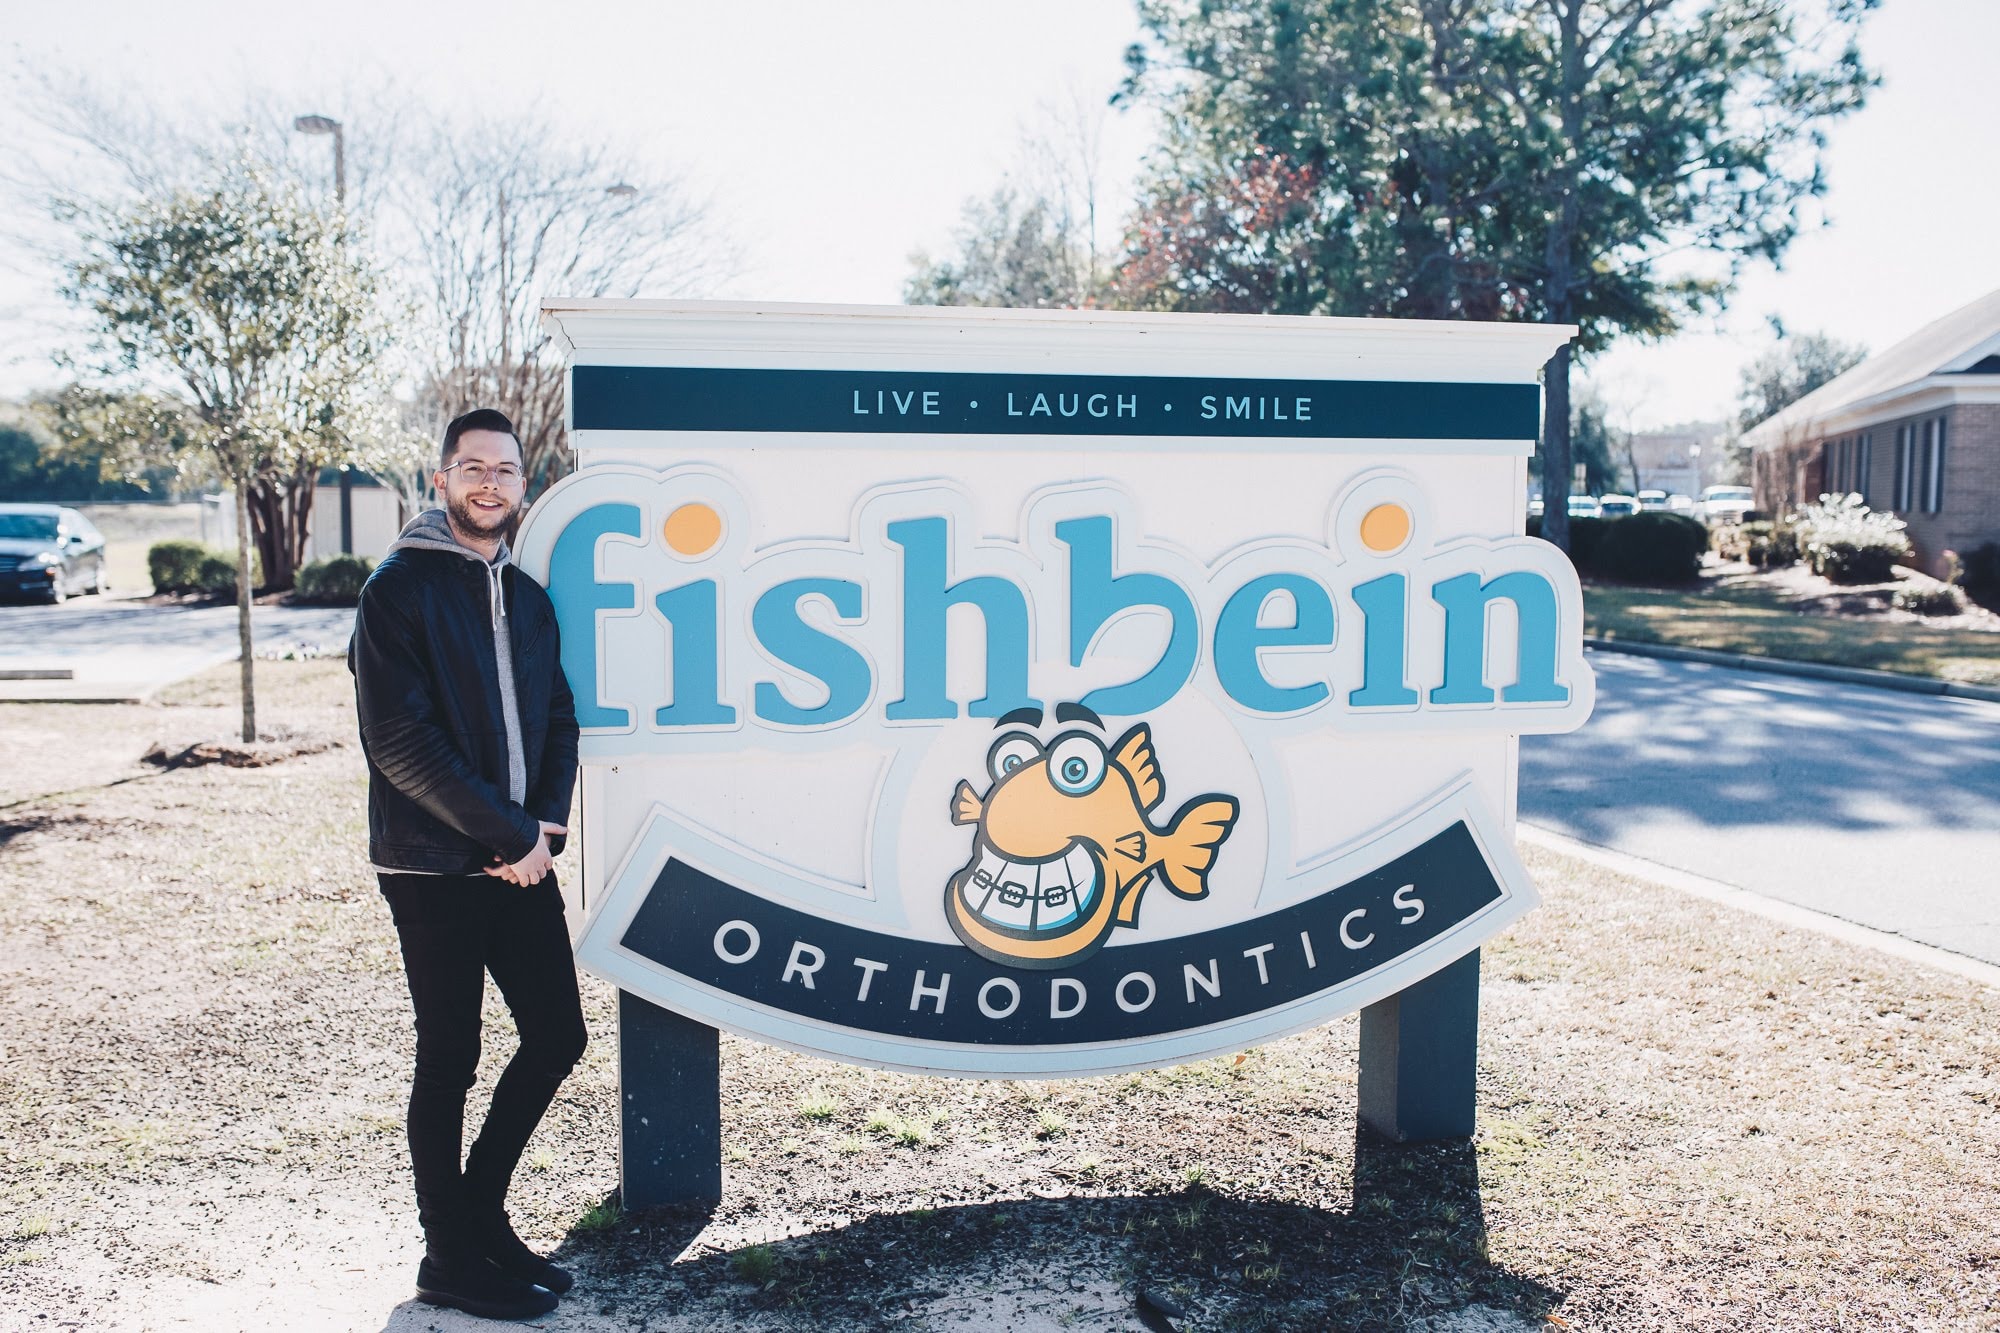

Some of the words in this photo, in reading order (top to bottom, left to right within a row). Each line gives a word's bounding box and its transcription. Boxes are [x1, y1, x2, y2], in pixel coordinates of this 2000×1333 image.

[853, 390, 941, 415] LIVE
[1006, 393, 1138, 418] LAUGH
[1200, 395, 1313, 421] SMILE
[547, 502, 1569, 728] fishbein
[713, 882, 1425, 1020] ORTHODONTICS
